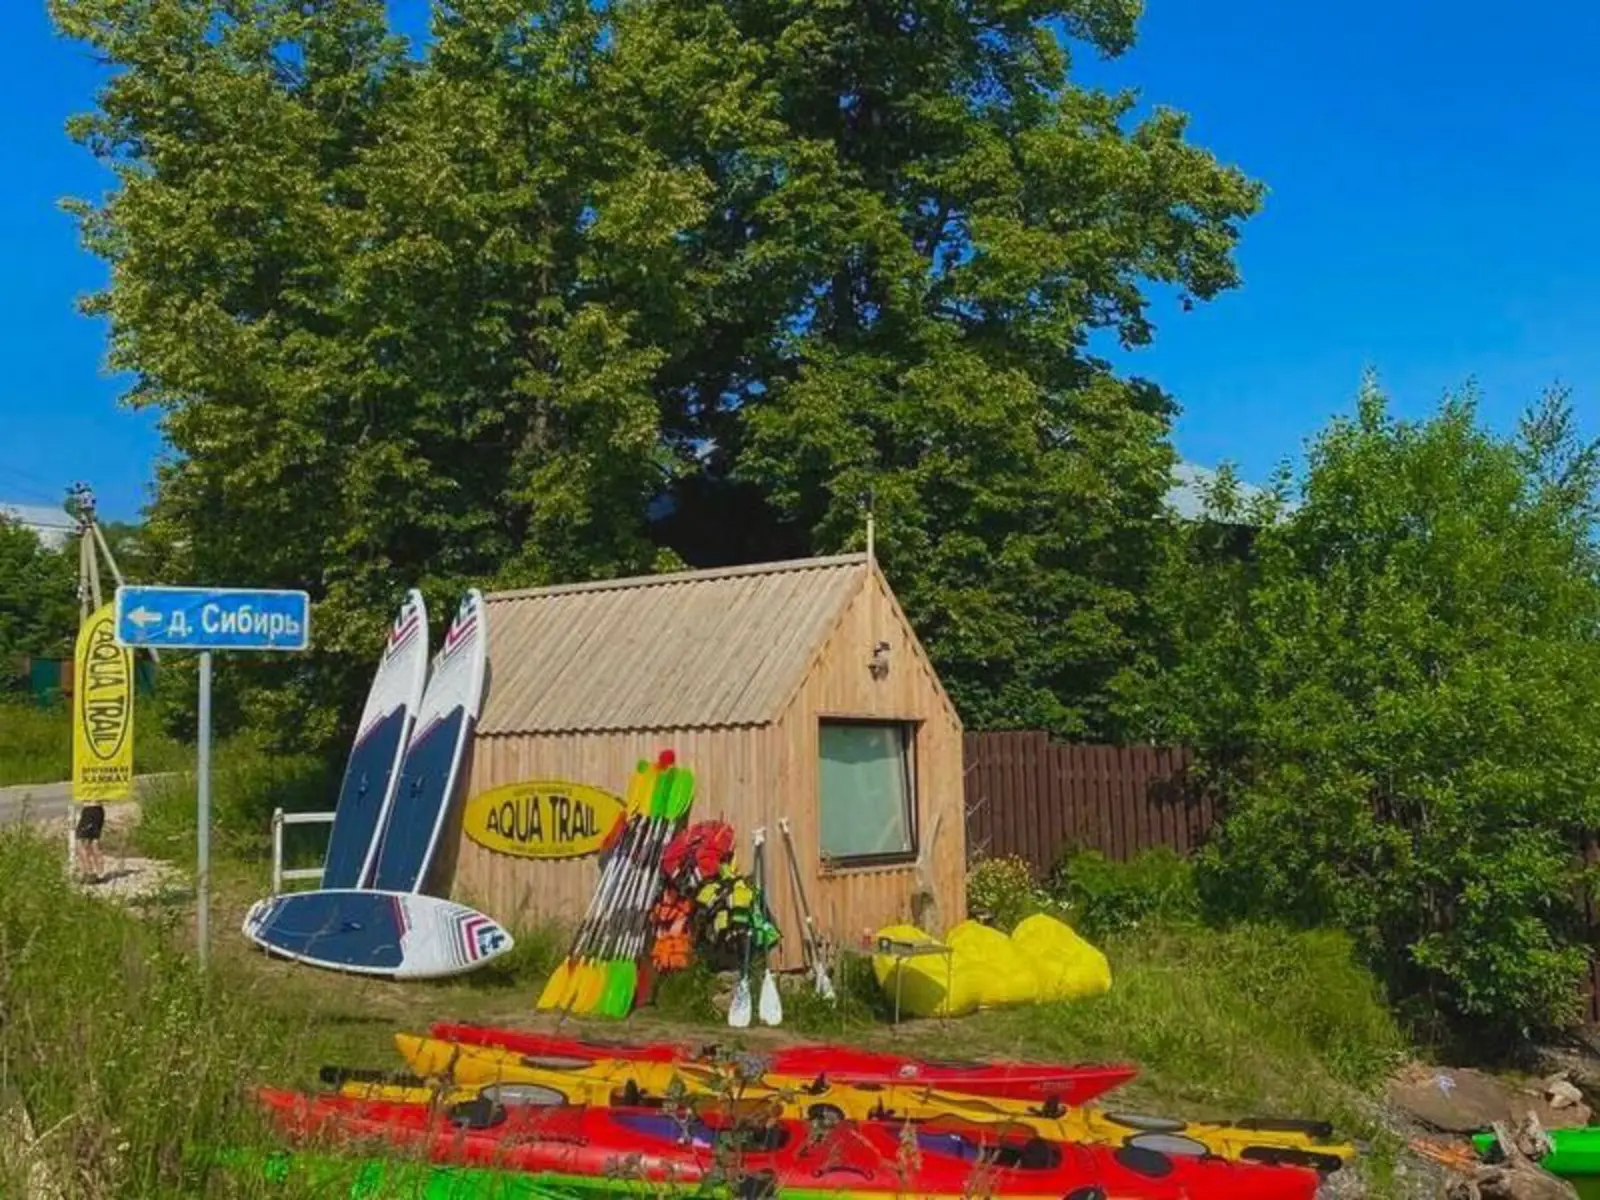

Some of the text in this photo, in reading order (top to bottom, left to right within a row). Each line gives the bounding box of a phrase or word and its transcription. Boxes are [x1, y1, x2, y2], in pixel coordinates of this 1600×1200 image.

[167, 603, 300, 641] д. Сибирь
[89, 629, 125, 691] AQUA
[88, 695, 125, 747] TRAIL
[486, 796, 600, 843] AQUA TRAIL
